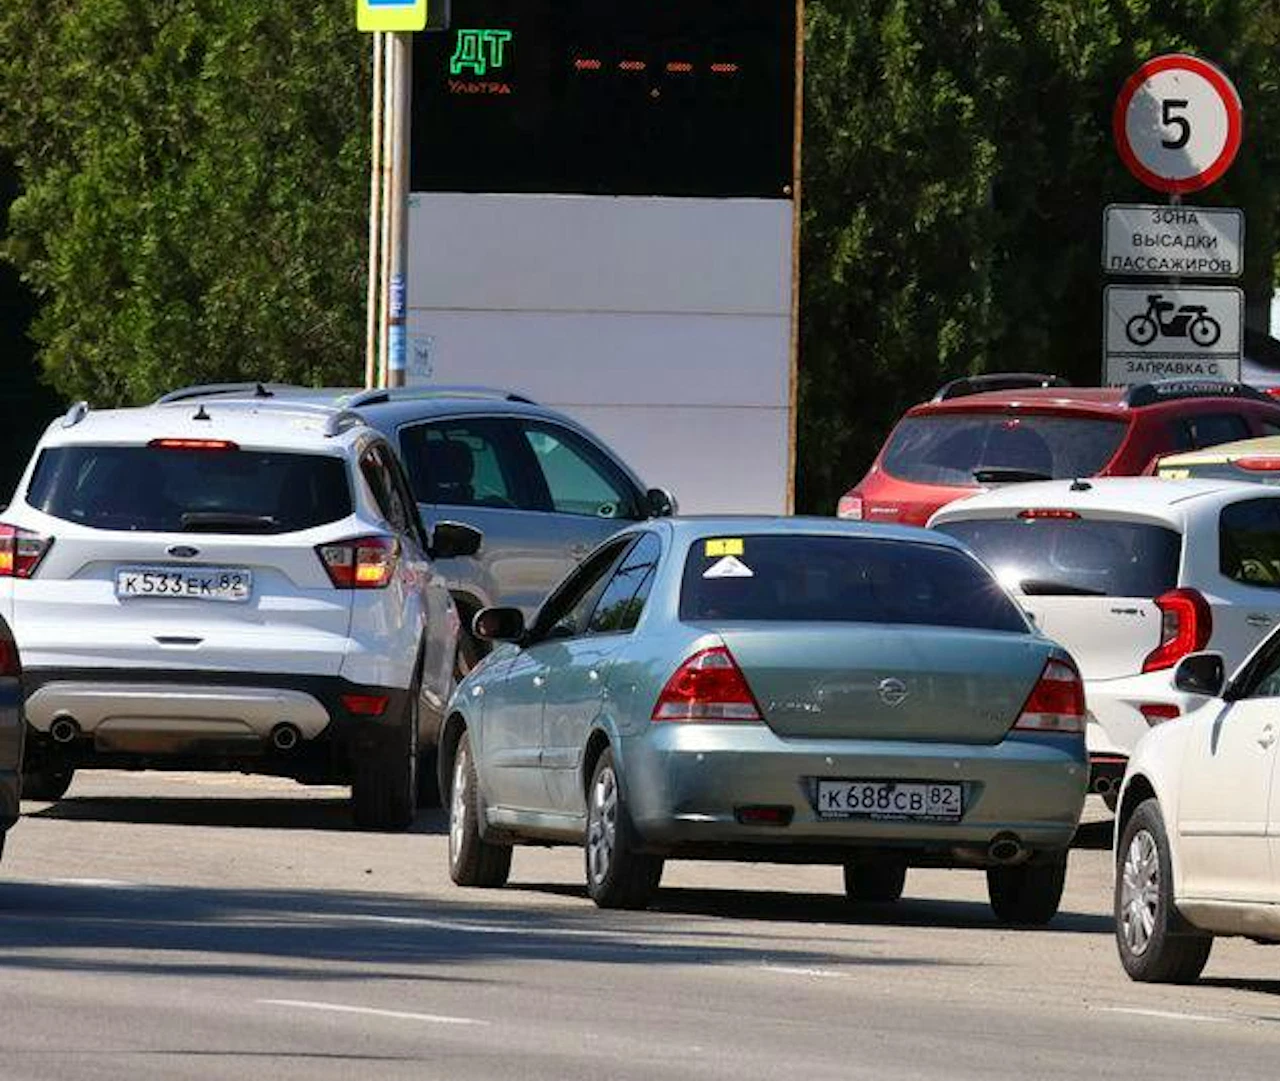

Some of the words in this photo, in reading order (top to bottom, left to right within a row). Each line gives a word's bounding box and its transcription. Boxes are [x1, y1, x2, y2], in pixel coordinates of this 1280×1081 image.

[449, 29, 512, 75] ДТ
[1161, 99, 1191, 149] 5
[1151, 209, 1199, 224] ЗОНА
[1132, 233, 1218, 250] ВЫСАДКИ
[1111, 256, 1233, 272] ПАССАЖИРОВ
[1127, 361, 1204, 375] ЗАПРАВКА
[126, 573, 211, 595] К533ЕК
[219, 575, 243, 591] 82
[828, 785, 922, 811] К688СВ
[931, 787, 953, 805] 82
